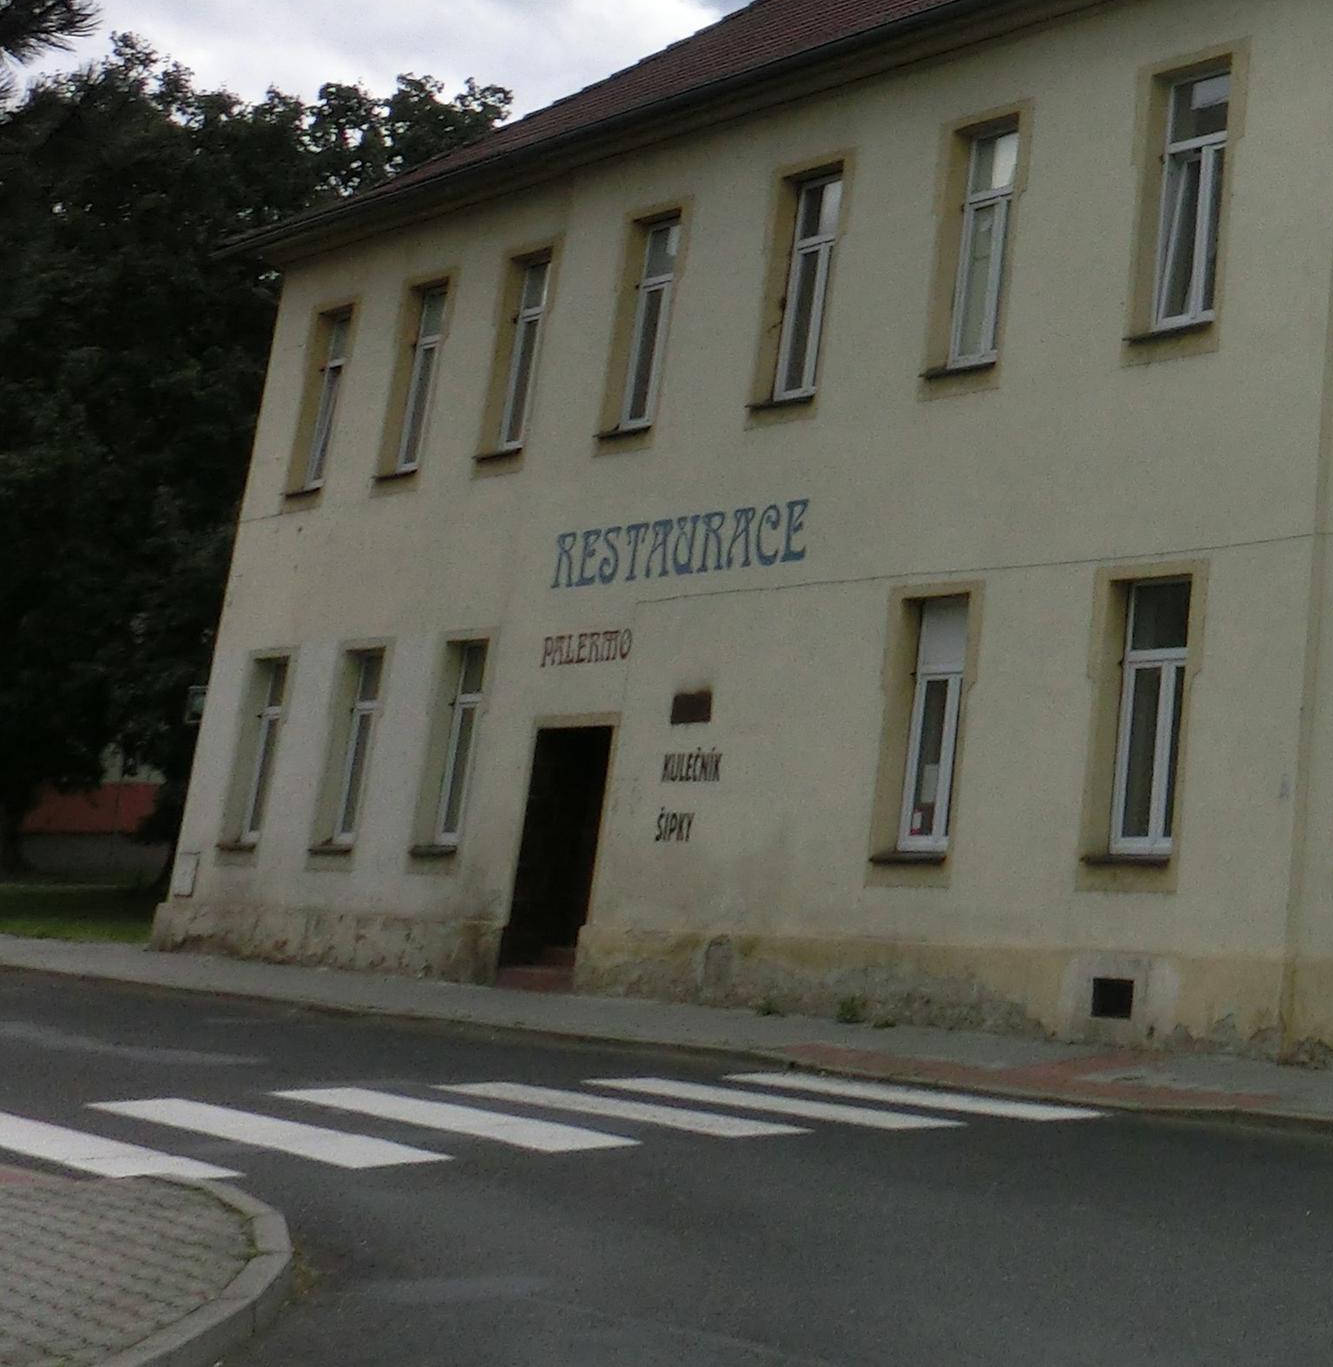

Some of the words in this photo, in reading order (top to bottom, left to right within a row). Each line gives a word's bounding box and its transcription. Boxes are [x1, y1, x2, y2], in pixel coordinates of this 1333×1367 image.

[551, 498, 810, 589] RESTAURACE
[541, 628, 633, 668] PALERMO
[661, 747, 723, 782] KULEČNÍK
[655, 807, 695, 842] ŠIPKY
